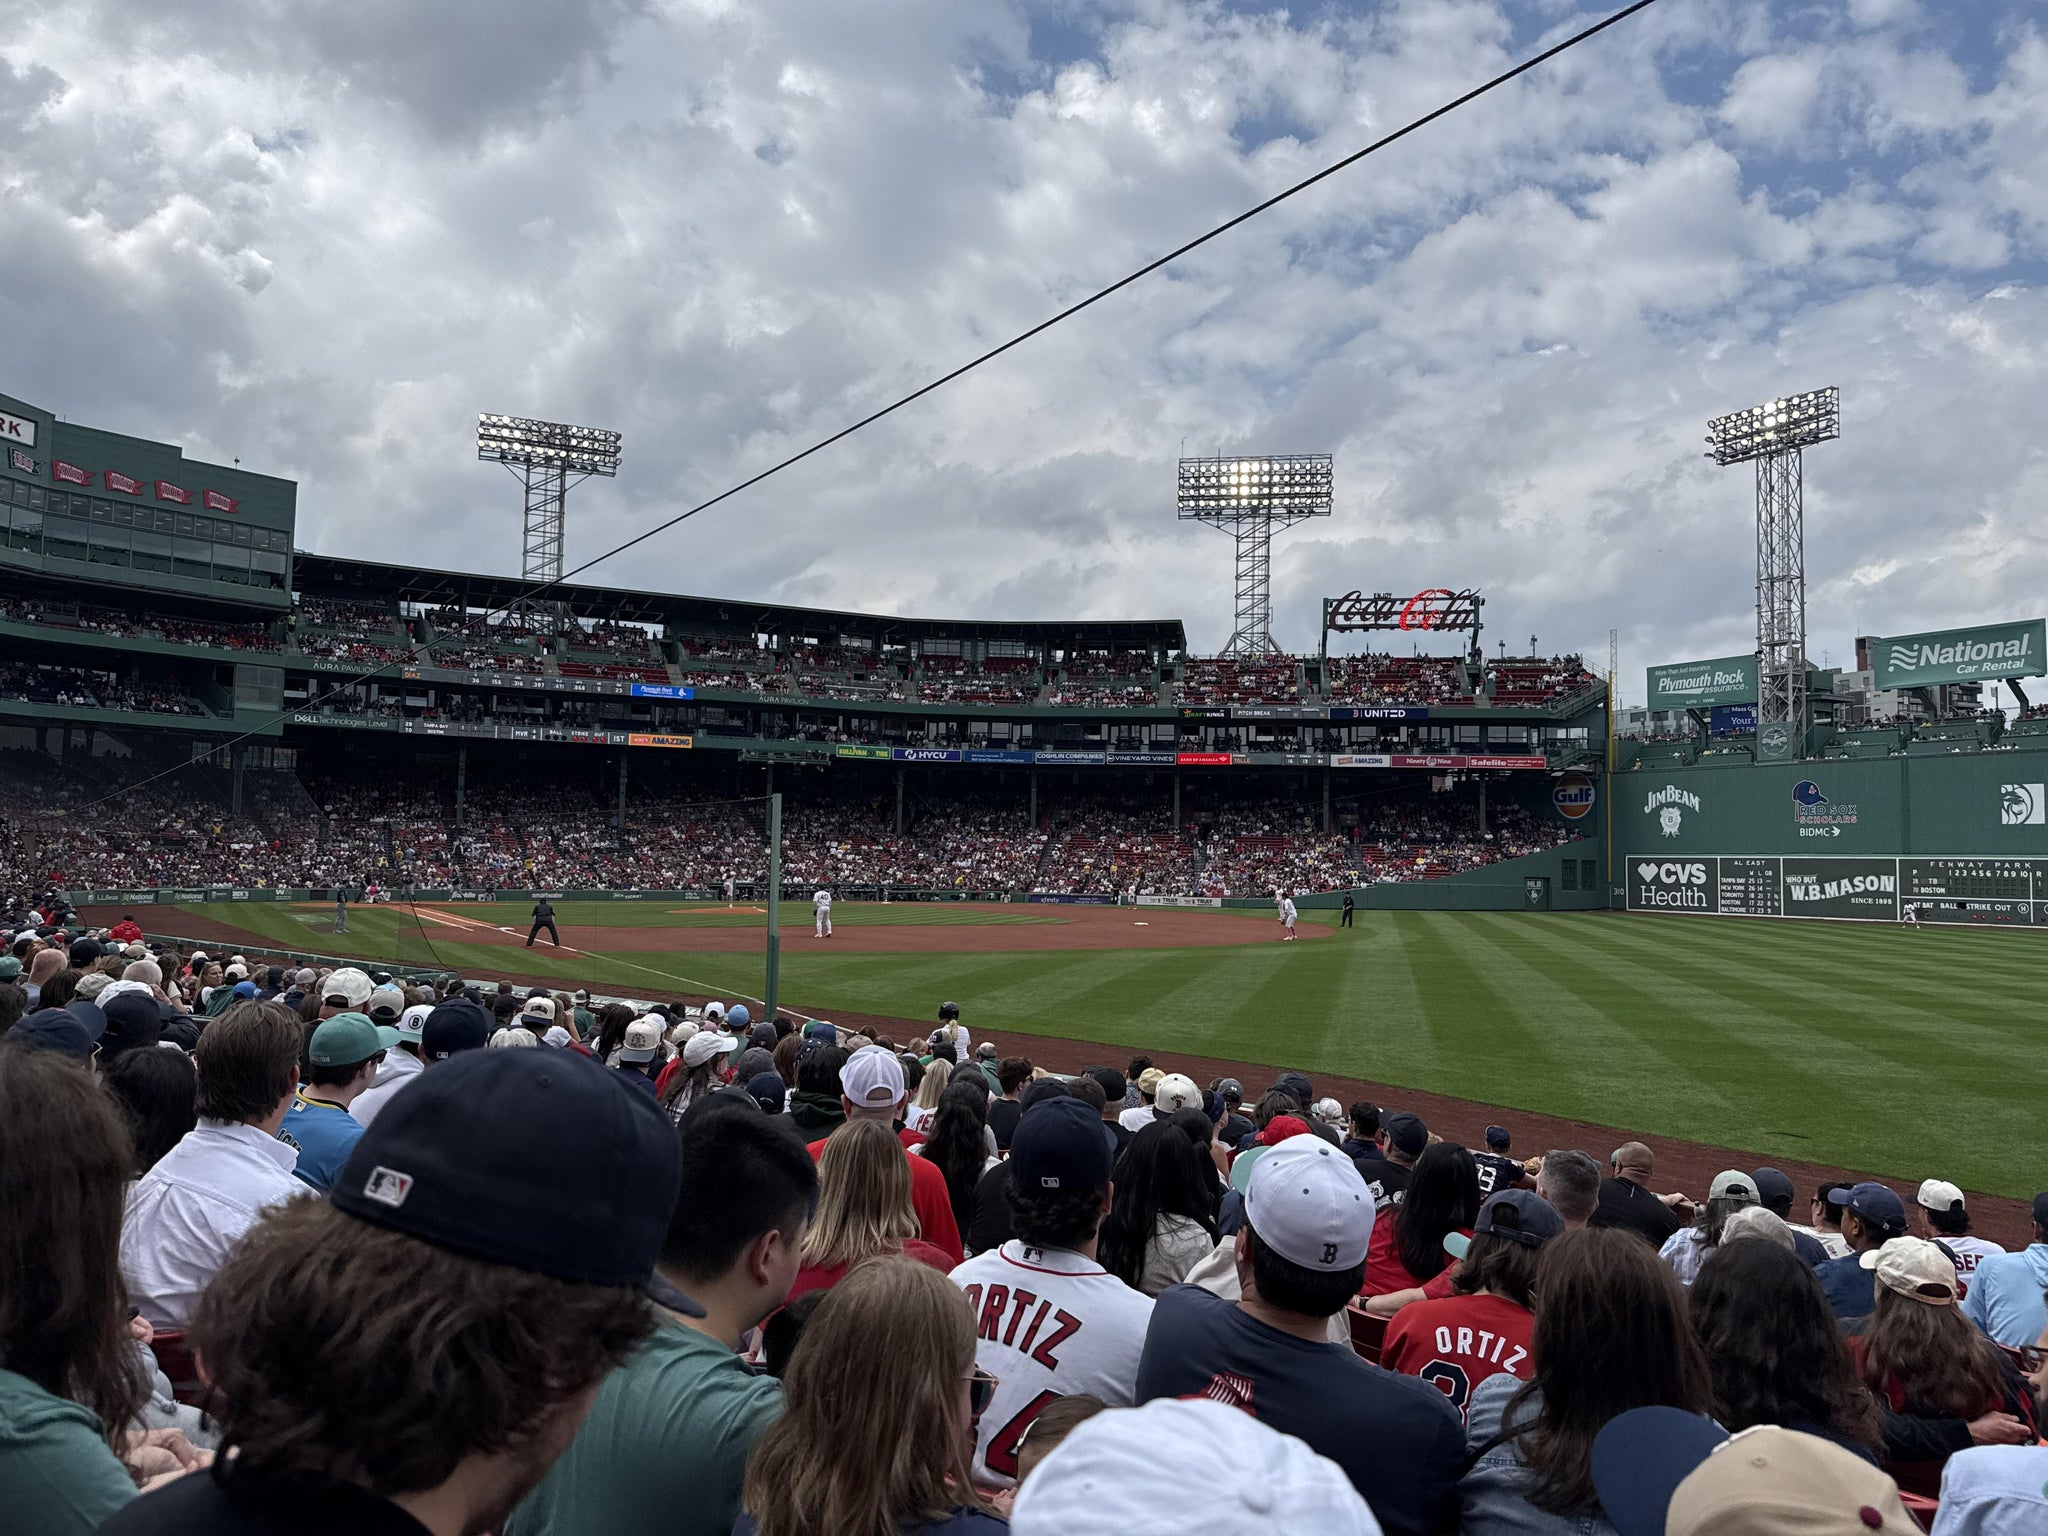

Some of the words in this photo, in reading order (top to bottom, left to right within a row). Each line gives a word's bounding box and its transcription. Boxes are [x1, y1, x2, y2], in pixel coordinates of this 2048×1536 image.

[1920, 633, 2030, 666] National
[342, 665, 378, 673] PAVILION
[1956, 664, 1978, 674] Car
[1982, 659, 2024, 672] Rental
[1659, 674, 1711, 691] Plymouth
[1714, 669, 1744, 685] Rock
[1704, 683, 1744, 694] assurance
[781, 697, 808, 705] PAVILION
[1365, 710, 1406, 718] UNITED
[295, 715, 318, 723] DELL
[318, 716, 367, 727] Technologies
[368, 720, 388, 728] Level
[651, 737, 690, 746] AMAZING
[838, 747, 867, 756] SULLIVAN
[1554, 787, 1592, 803] Gulf
[1800, 805, 1825, 815] RED
[1830, 805, 1857, 815] SOX
[1800, 815, 1857, 824] SCHOLARS
[1800, 827, 1829, 837] BIDMC
[1660, 863, 1707, 884] CVS
[1613, 887, 1624, 895] 310
[1640, 886, 1707, 907] Health
[1966, 903, 1991, 911] STRIKE
[1175, 1100, 1182, 1108] B
[916, 1115, 931, 1131] PE
[1319, 1243, 1339, 1264] B
[1435, 1326, 1528, 1373] ORTIZ
